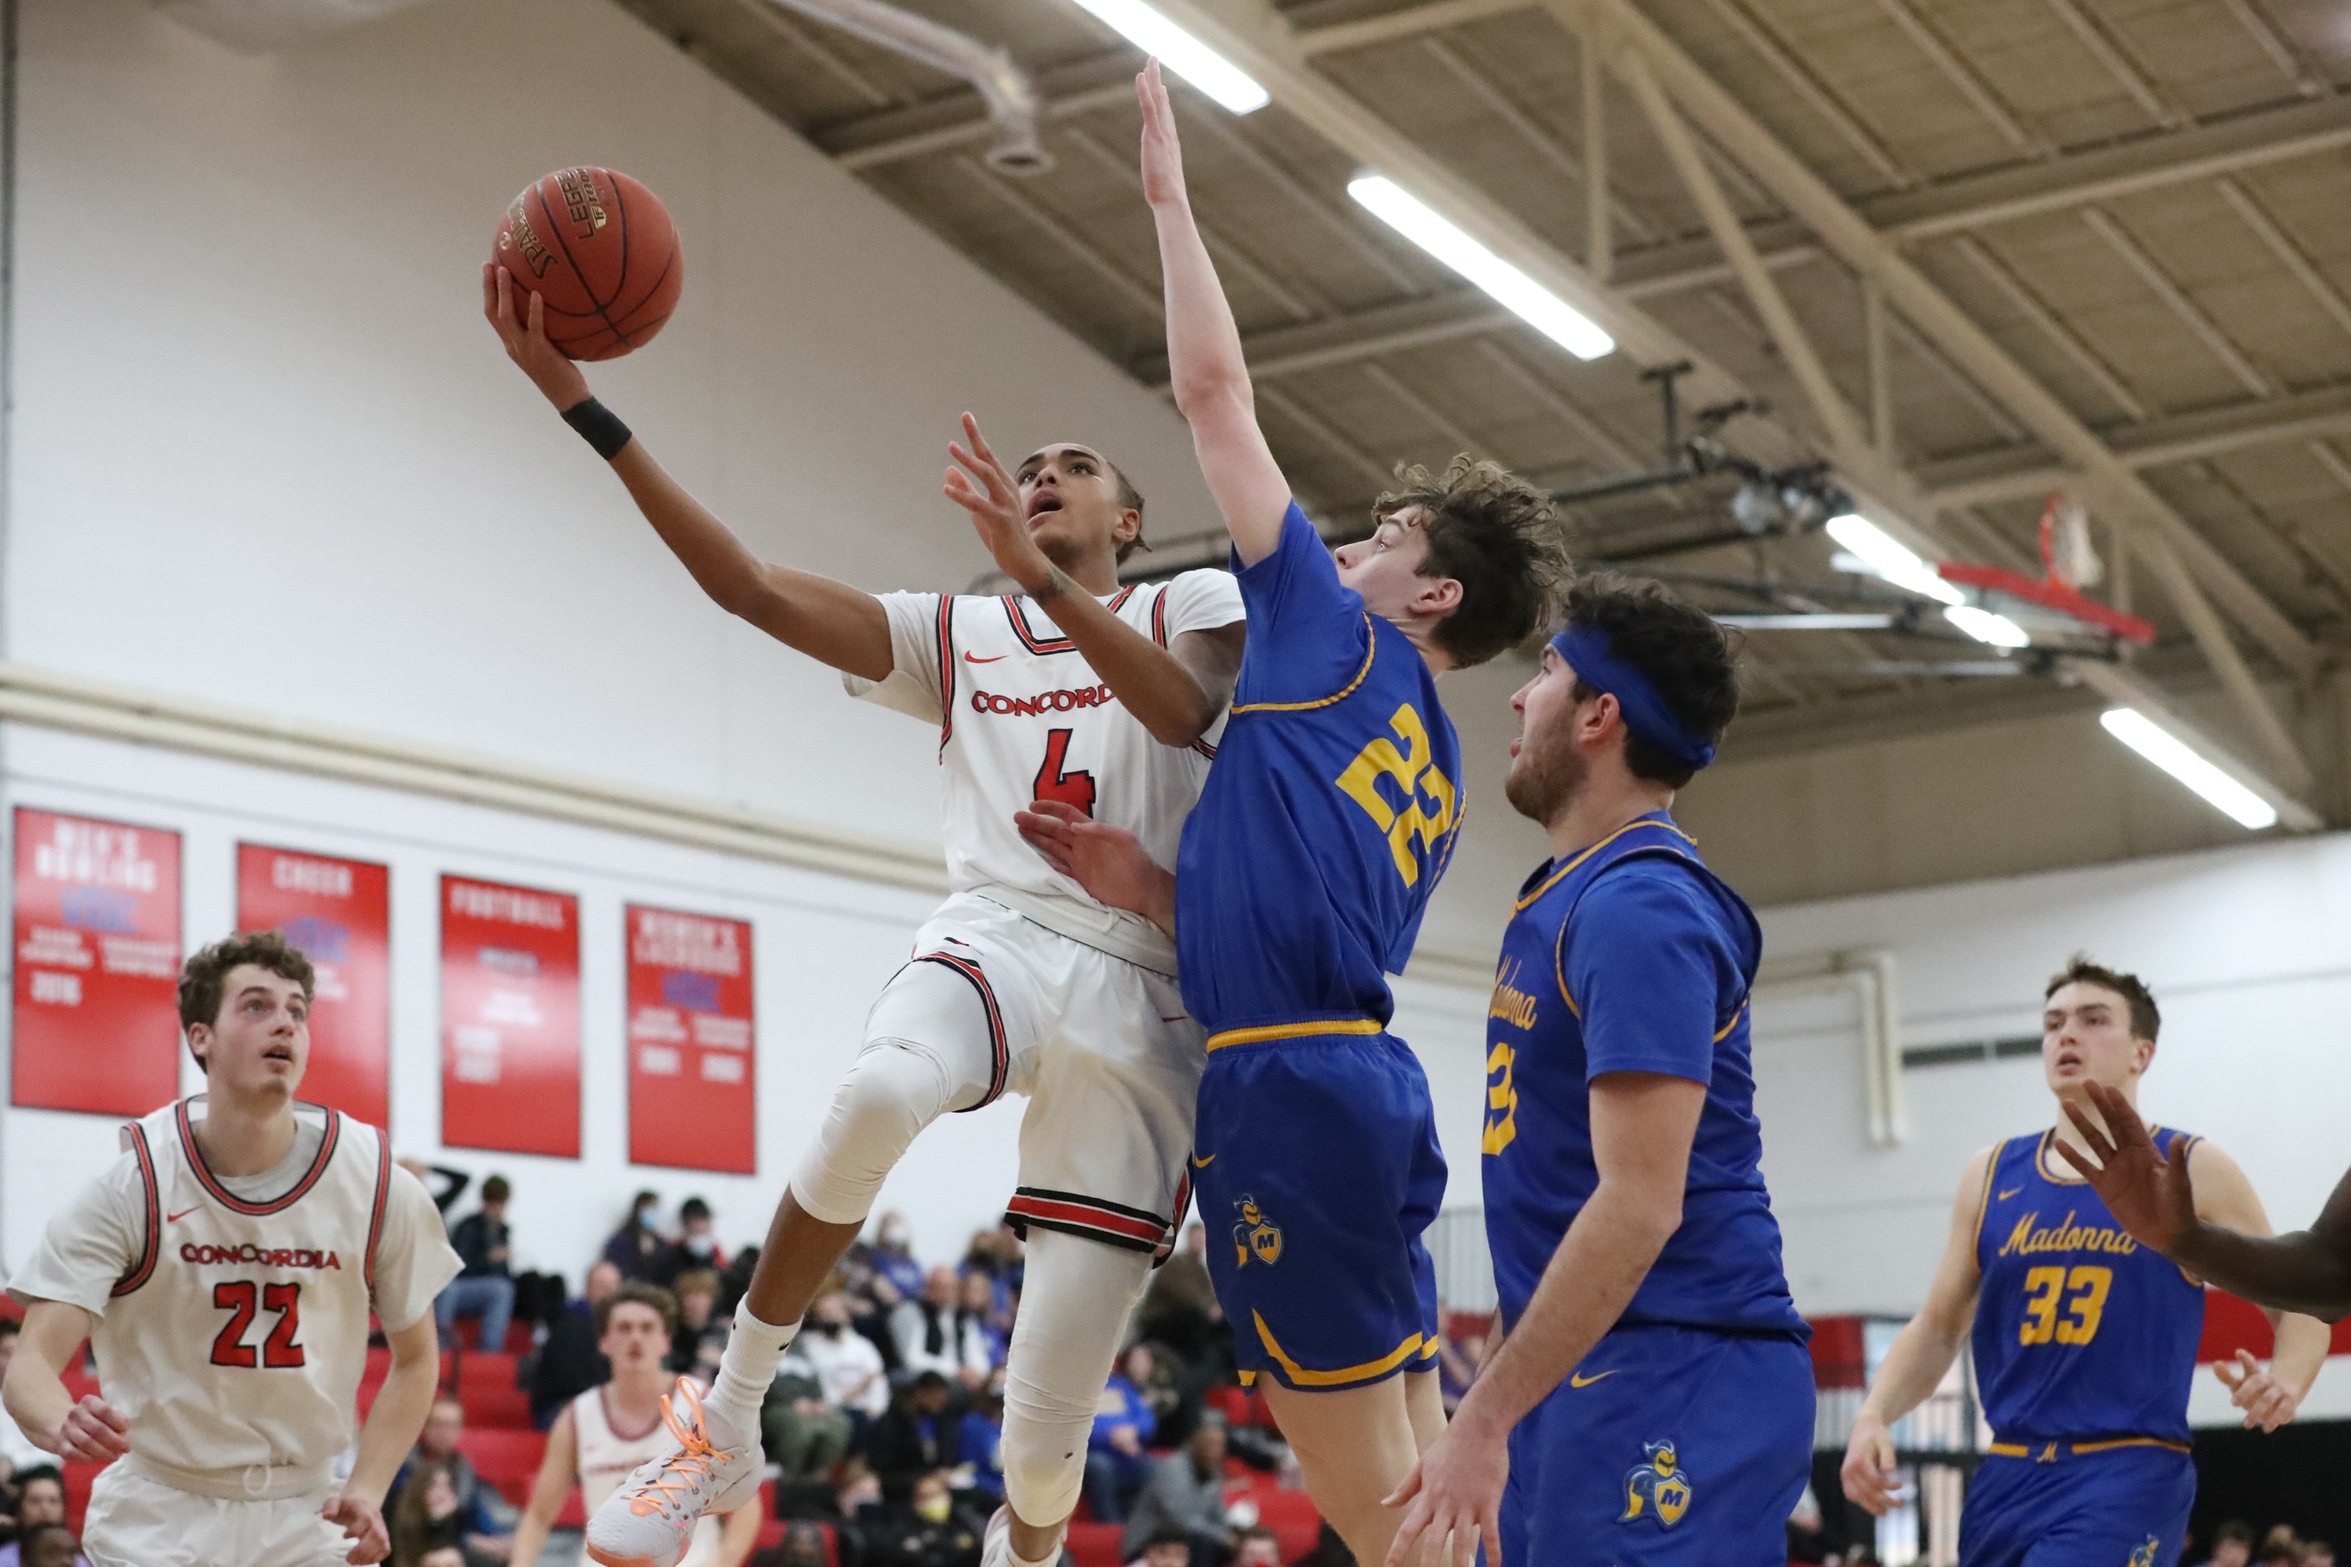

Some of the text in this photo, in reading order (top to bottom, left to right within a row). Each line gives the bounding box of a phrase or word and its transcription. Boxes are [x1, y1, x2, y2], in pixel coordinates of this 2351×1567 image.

[971, 683, 1116, 717] CONCORD
[1032, 727, 1097, 820] 4
[1334, 702, 1457, 889] 22
[451, 884, 564, 930] FOOTBALL
[180, 1242, 341, 1270] CONCORDIA
[1257, 1233, 1275, 1250] M
[1999, 1209, 2137, 1257] Madonna
[210, 1280, 305, 1368] 22
[2019, 1265, 2114, 1346] 33
[1660, 1488, 1684, 1508] M
